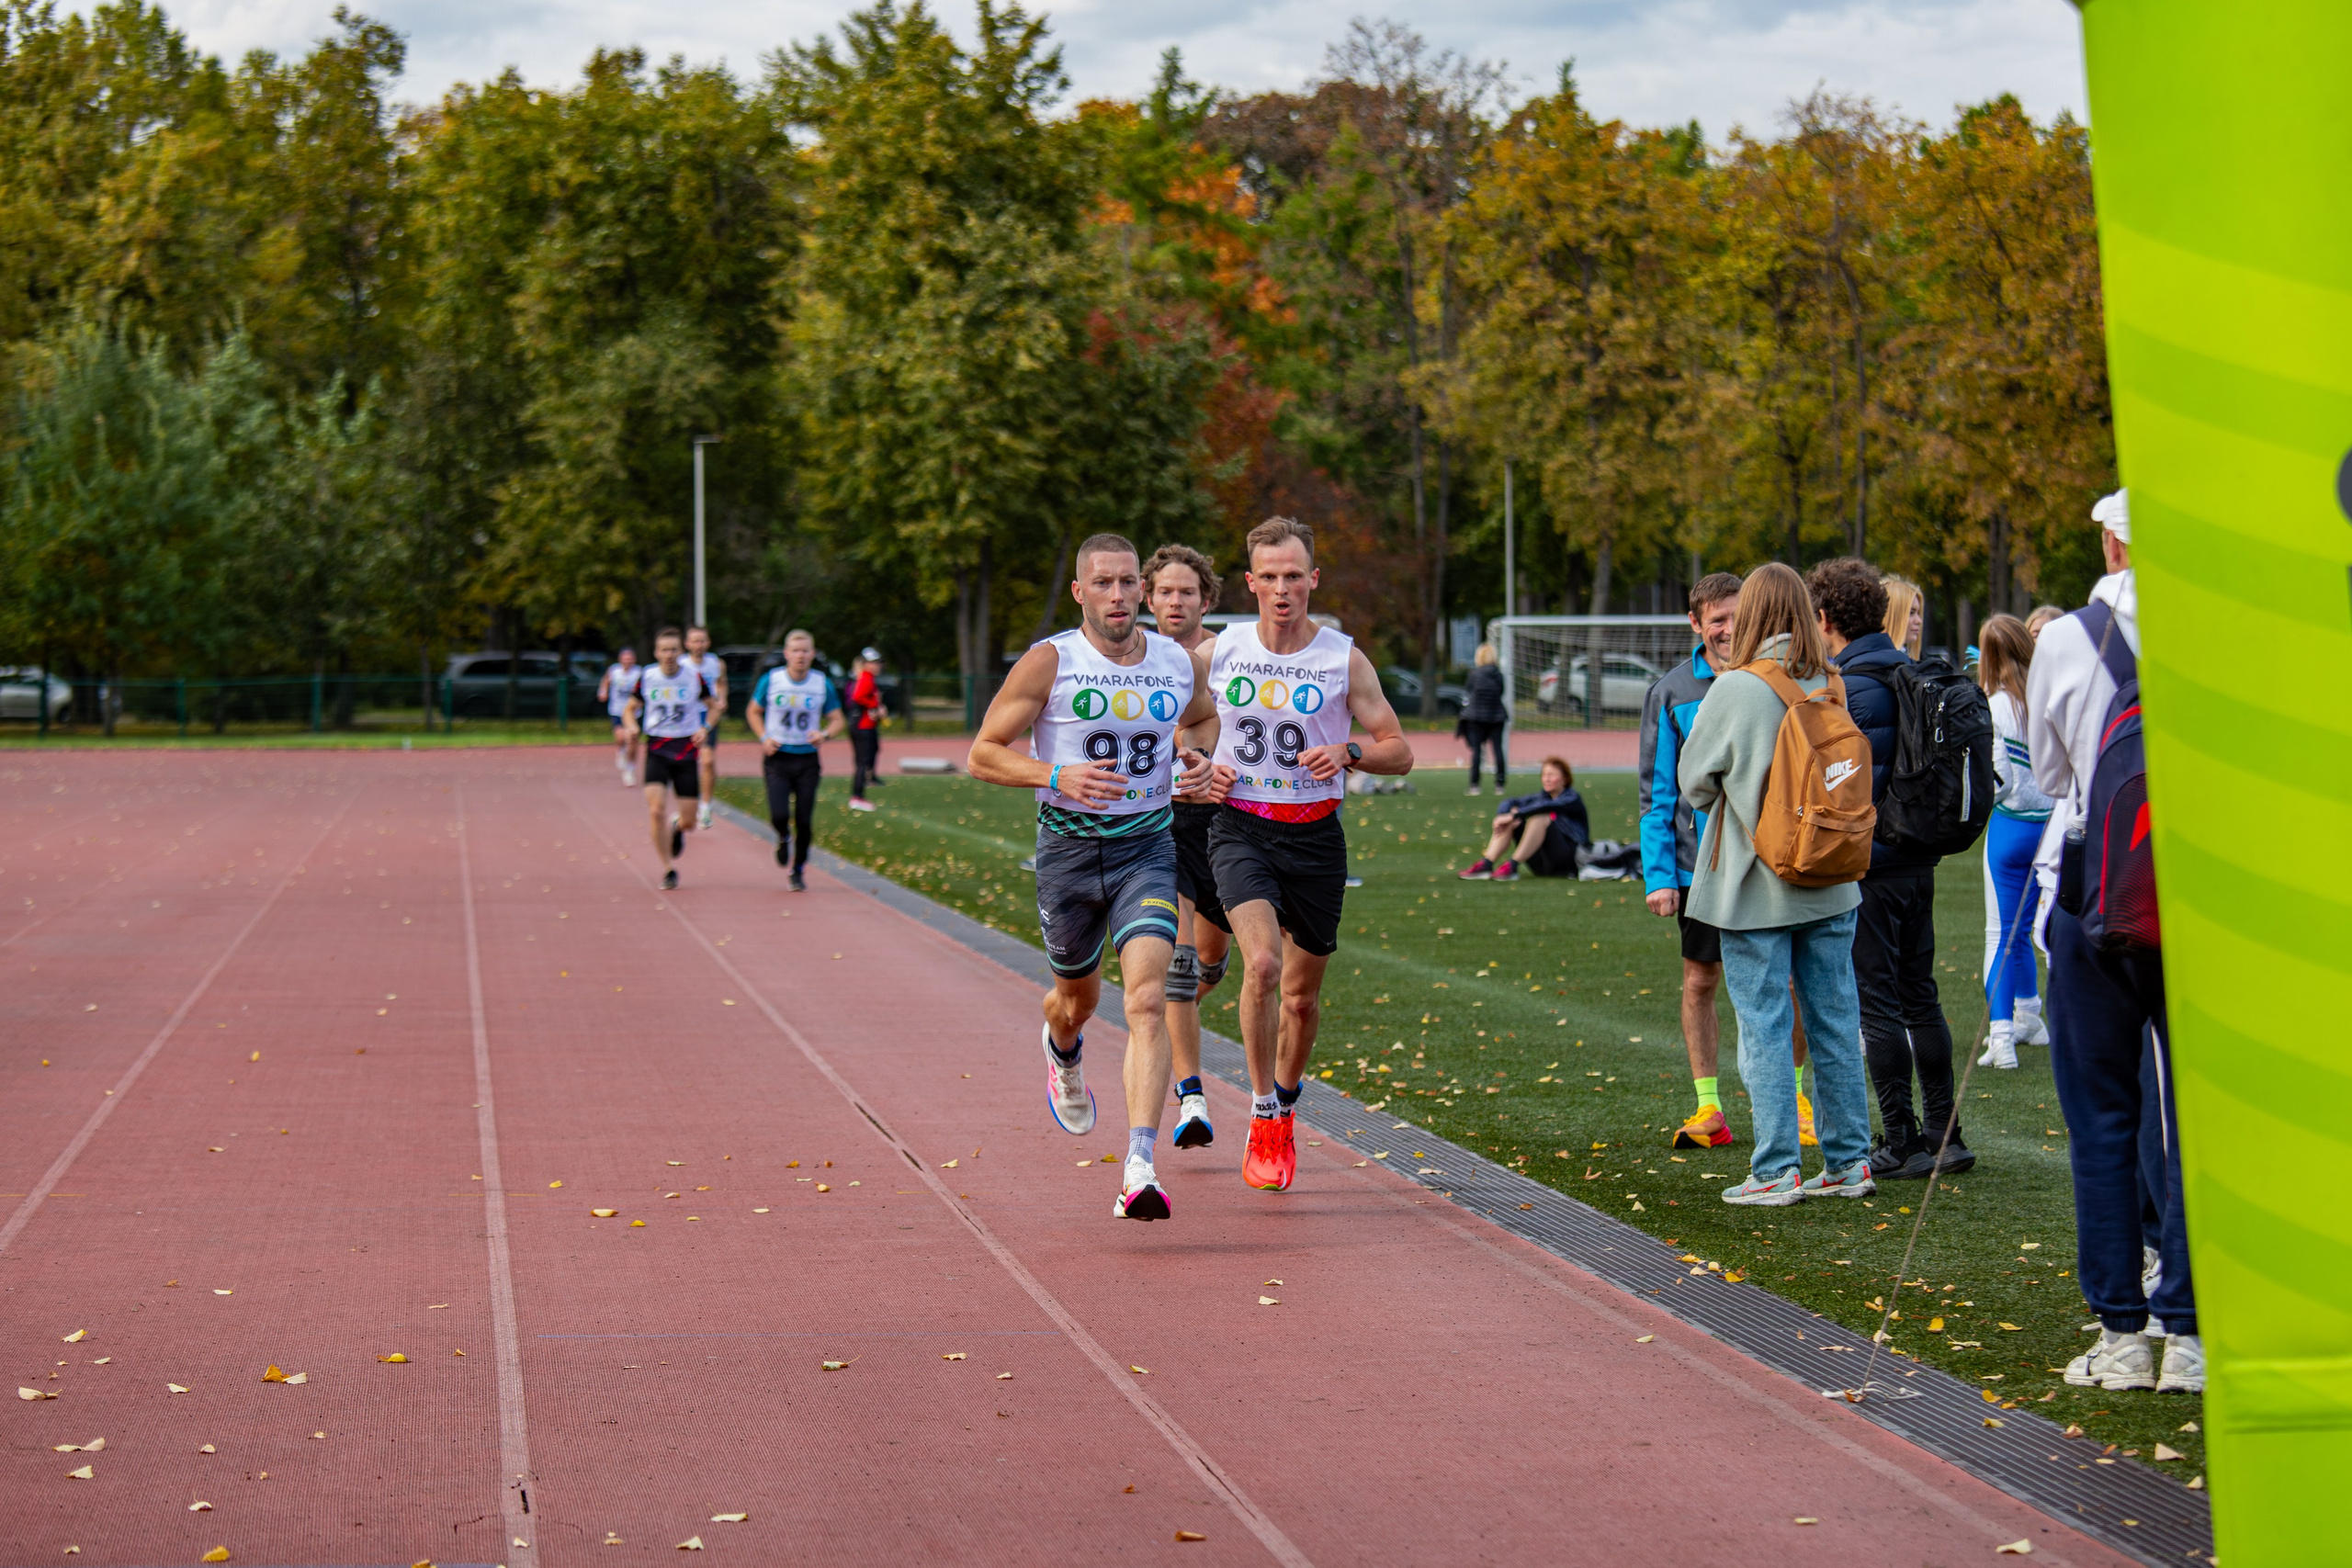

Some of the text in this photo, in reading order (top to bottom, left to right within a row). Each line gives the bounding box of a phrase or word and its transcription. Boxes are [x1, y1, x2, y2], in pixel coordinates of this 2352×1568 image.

[1073, 673, 1175, 687] VMARAFONE
[1230, 661, 1327, 682] VMARAFONE
[781, 711, 810, 731] 46
[1082, 729, 1160, 778] 98
[1234, 716, 1307, 771] 39
[1825, 758, 1853, 782] NIKE
[1236, 774, 1333, 790] ARAFONE.CLUB
